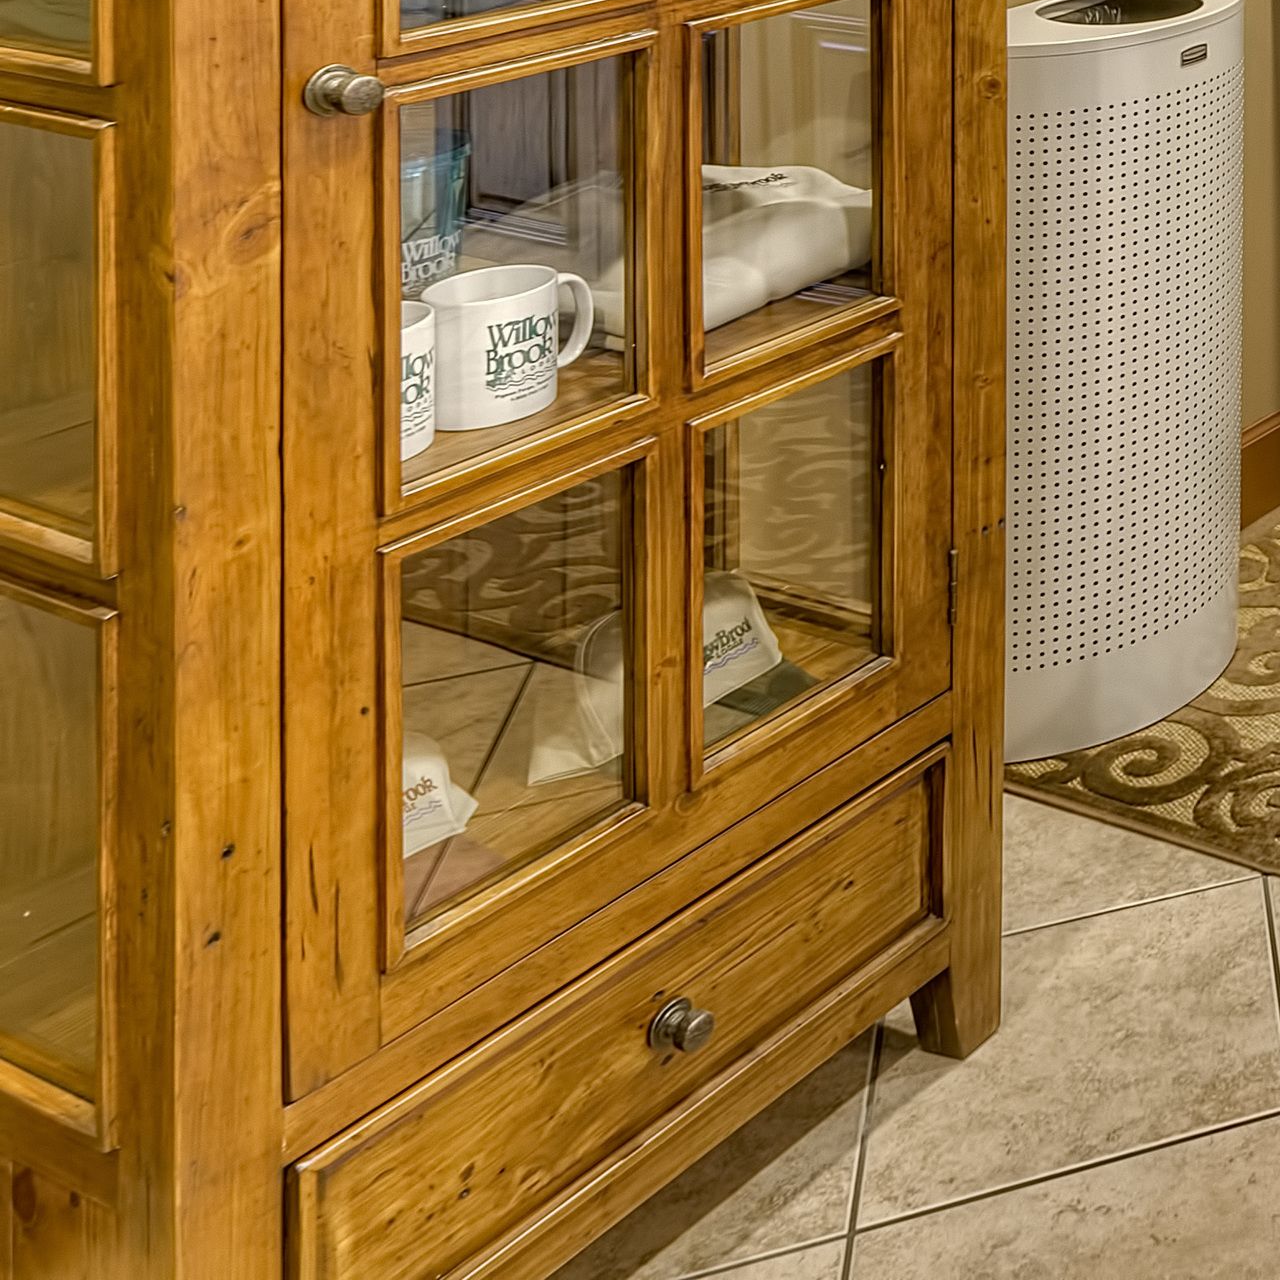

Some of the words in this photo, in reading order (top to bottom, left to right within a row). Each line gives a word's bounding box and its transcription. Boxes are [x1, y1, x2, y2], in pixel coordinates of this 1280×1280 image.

[401, 229, 463, 263] Willow
[401, 252, 456, 284] Brook
[487, 308, 559, 352] Willow
[485, 336, 553, 376] Brook
